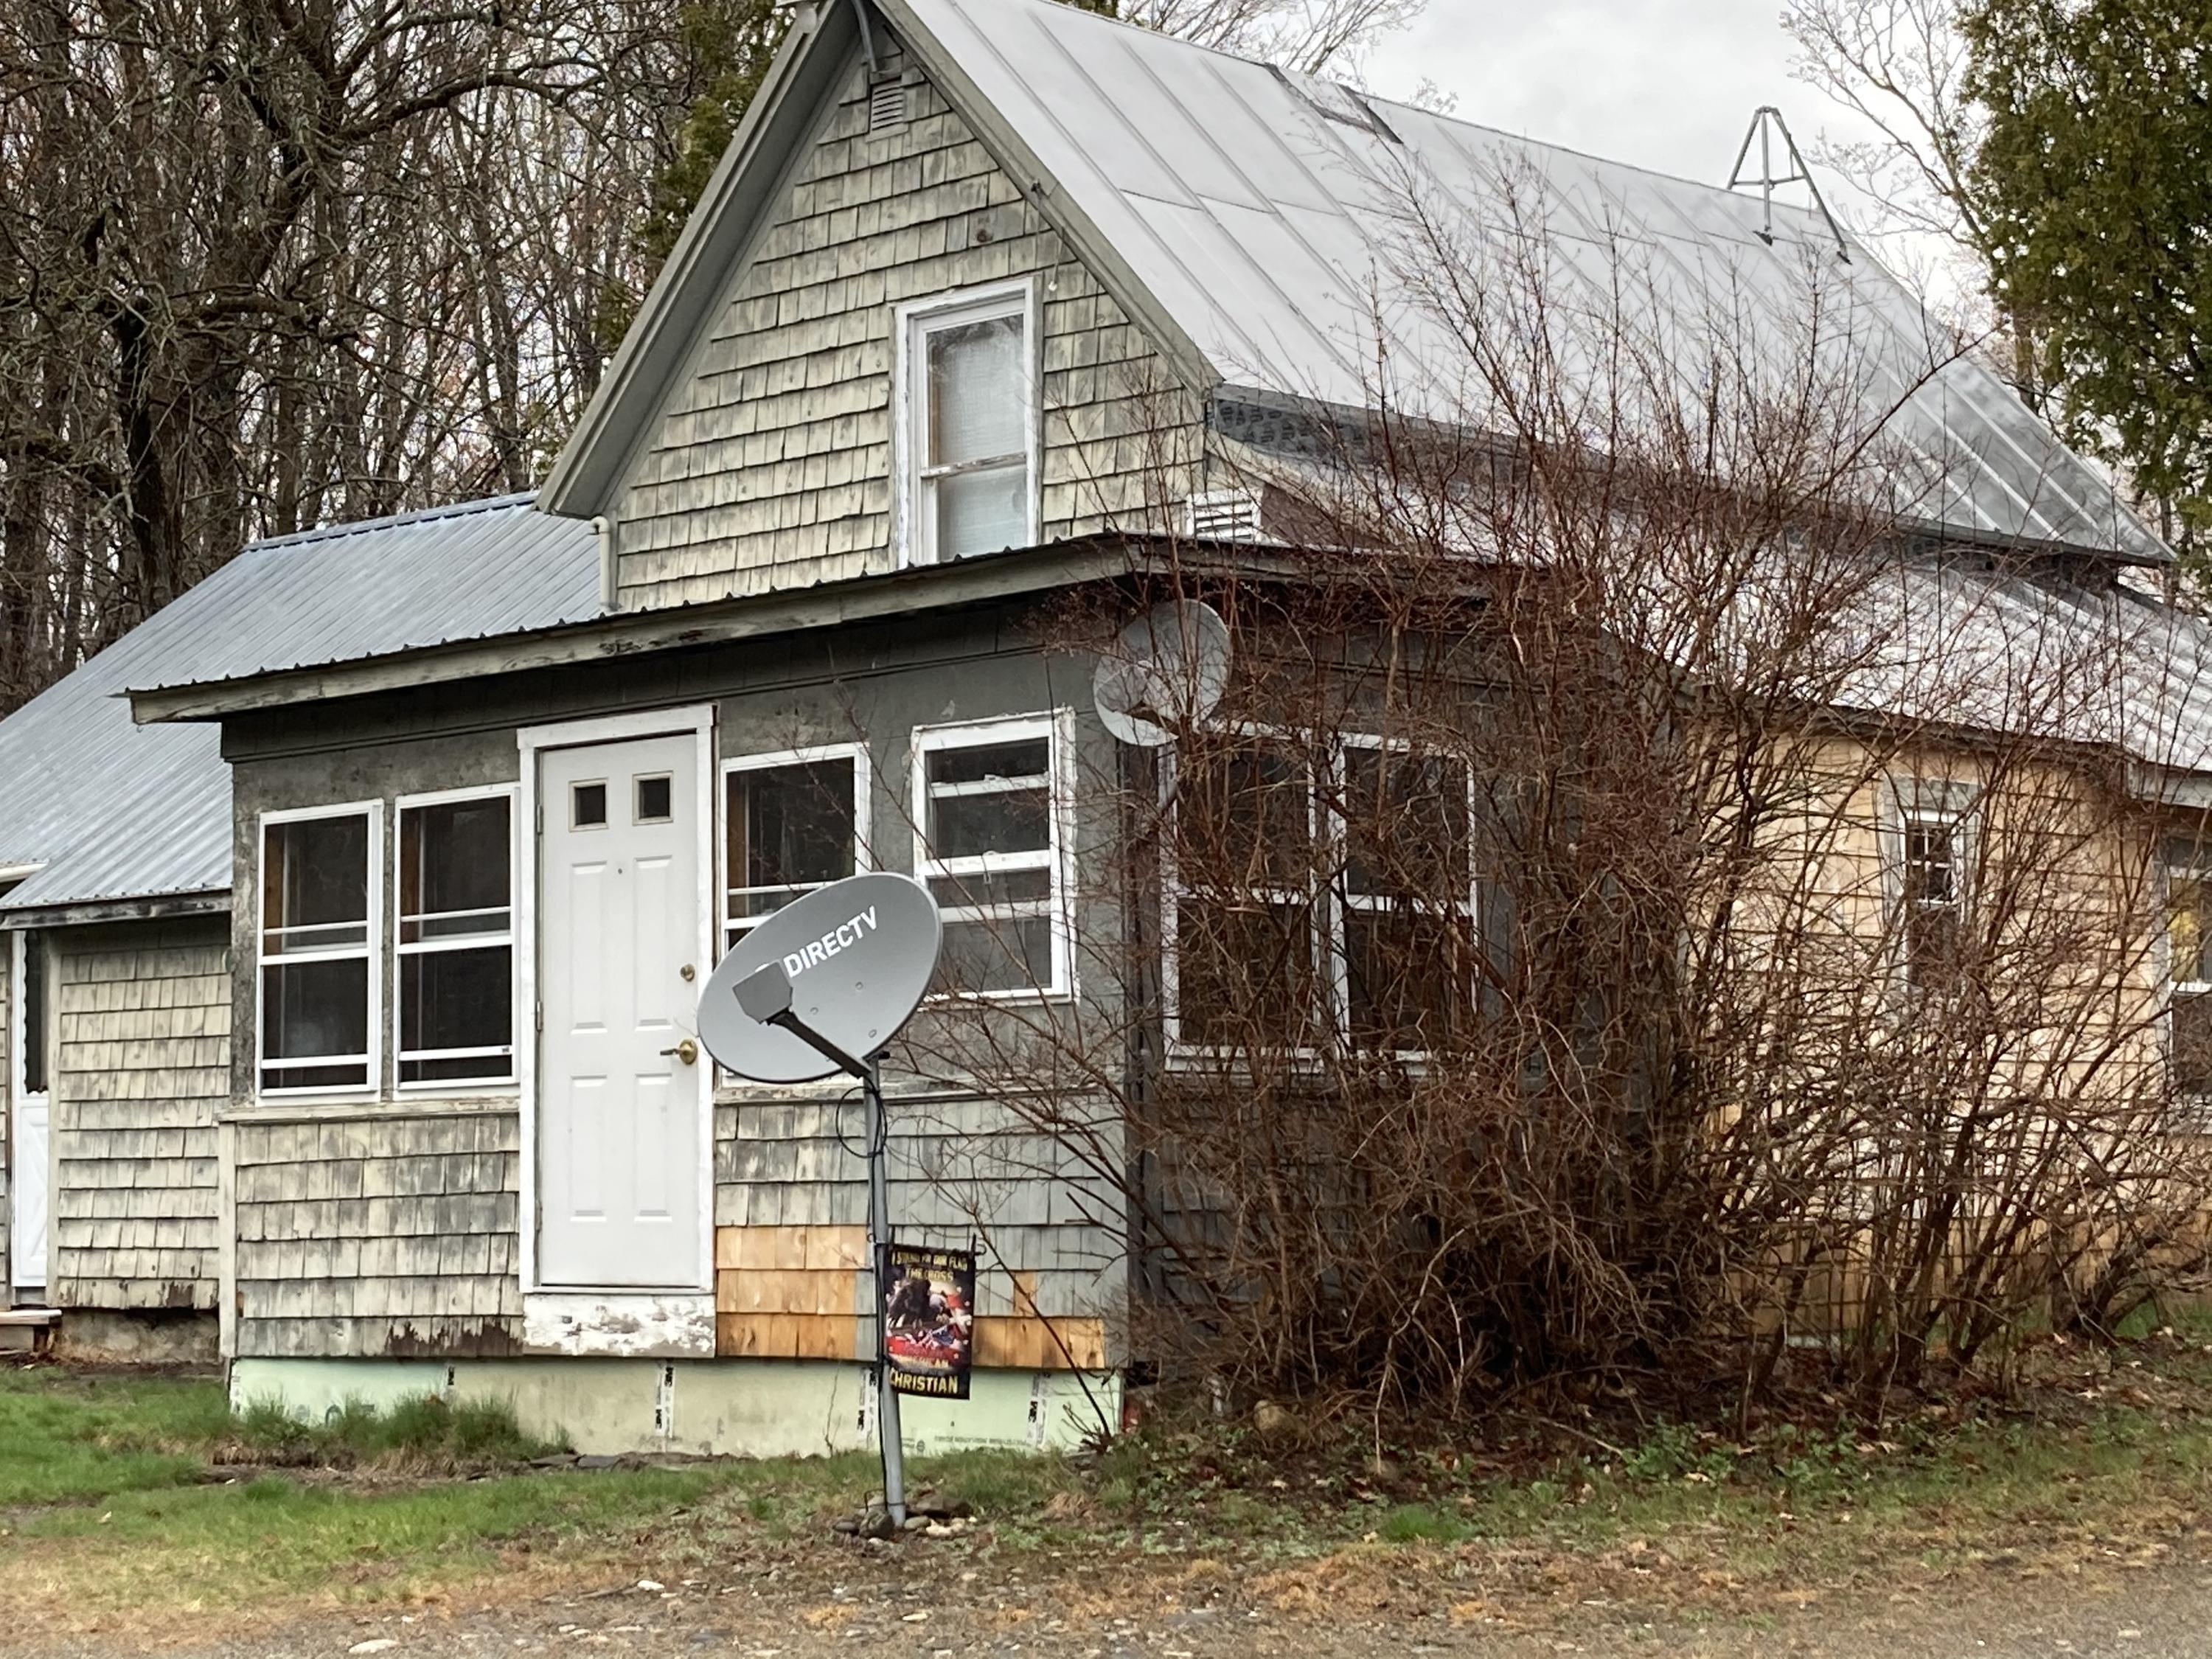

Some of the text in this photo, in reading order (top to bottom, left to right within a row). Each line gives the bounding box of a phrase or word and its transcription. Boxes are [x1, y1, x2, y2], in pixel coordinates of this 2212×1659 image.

[783, 905, 877, 978] DIRECTV
[664, 1367, 673, 1388] 3M
[889, 1367, 958, 1394] CHRISTIAN
[655, 1409, 662, 1430] 3M
[857, 1410, 865, 1430] 3M
[1029, 1400, 1038, 1423] 3M
